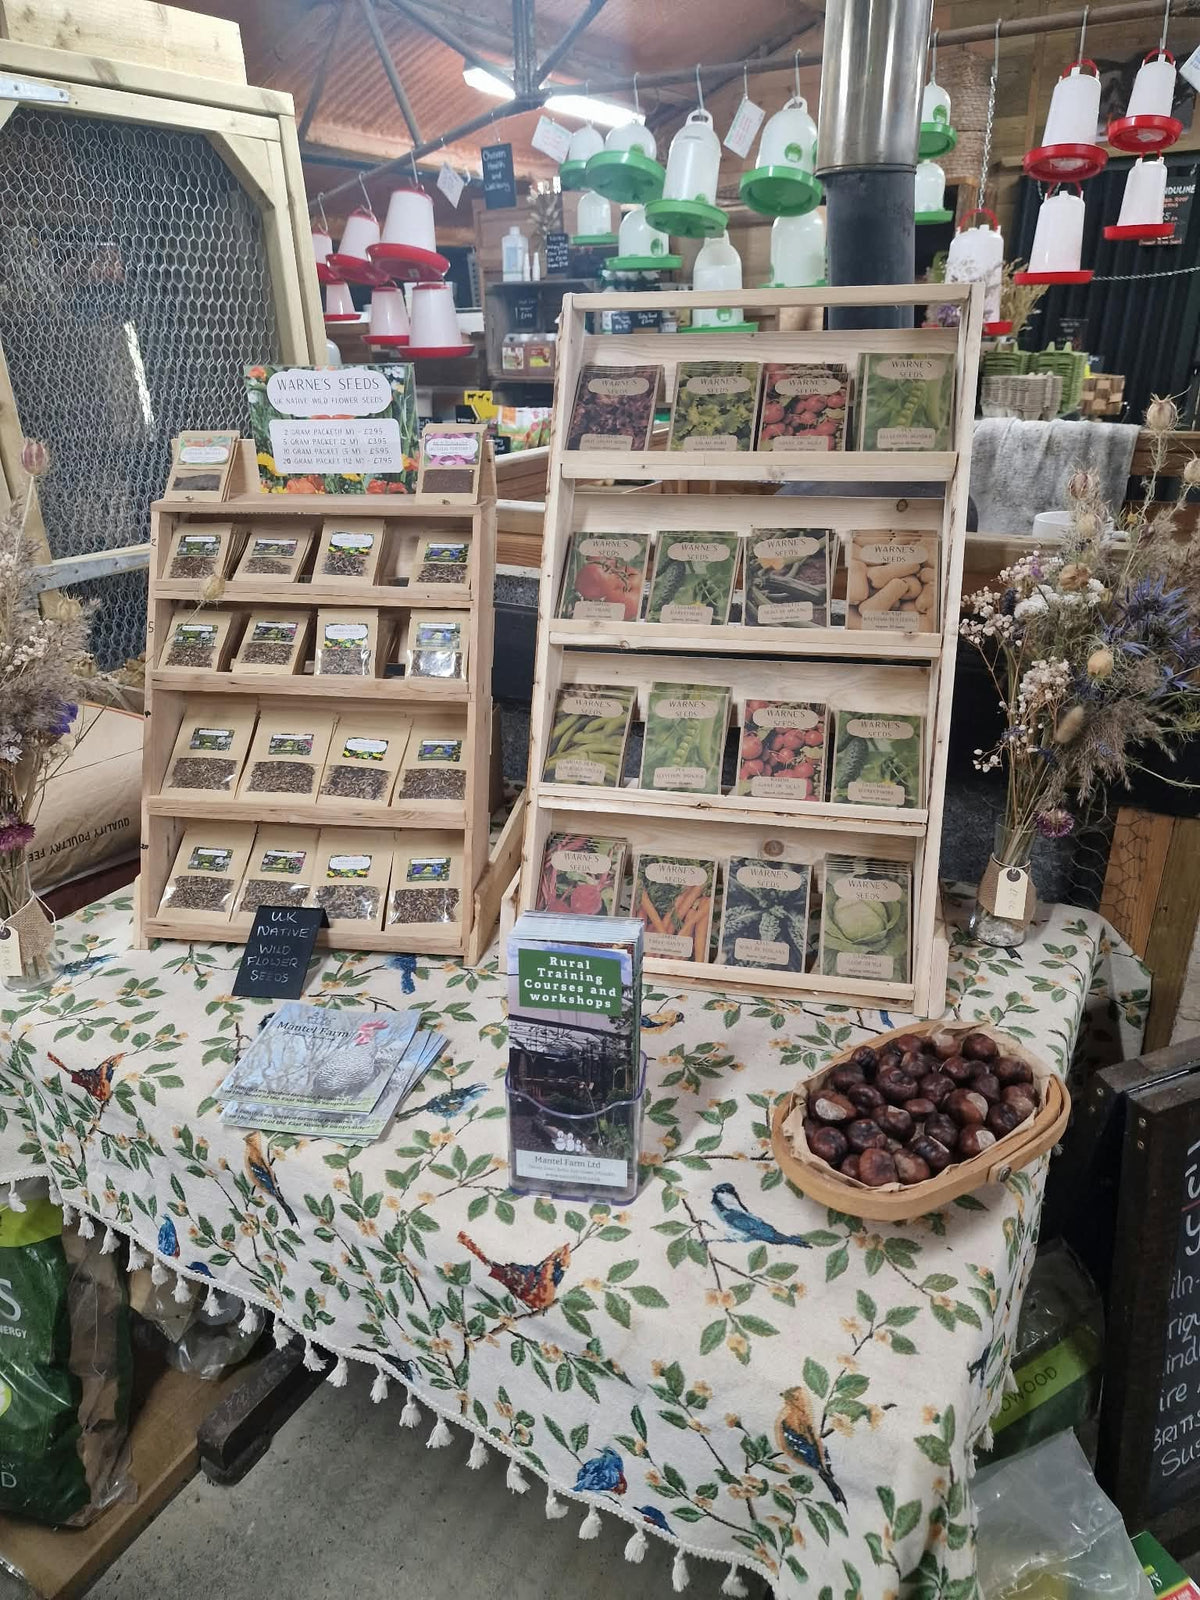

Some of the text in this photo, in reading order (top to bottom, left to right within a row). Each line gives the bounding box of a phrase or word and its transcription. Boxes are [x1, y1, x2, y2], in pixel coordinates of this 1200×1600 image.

[1164, 184, 1196, 194] NDULINE
[891, 360, 933, 369] WARNE'S
[276, 377, 380, 391] WARNE'S SEEDS
[601, 379, 638, 387] WARNE'S
[700, 377, 739, 386] WARNE'S
[286, 397, 308, 405] NATIVE
[283, 438, 288, 446] 5
[290, 438, 311, 446] GRAM
[592, 540, 629, 549] WARNE'S
[767, 539, 806, 549] WARNE'S
[874, 545, 915, 554] WARNE'S
[881, 555, 906, 563] SEEDS
[148, 620, 154, 633] 5
[575, 700, 612, 708] WARNE'S
[668, 700, 706, 708] WARNE'S
[766, 709, 806, 718] WARNE'S
[860, 721, 901, 730] WARNE'S
[868, 730, 892, 738] SEEDS
[93, 817, 130, 839] QUALITY
[49, 831, 91, 855] POULTRY
[563, 853, 600, 863] WARNE'S
[569, 864, 591, 872] SEEDS
[658, 864, 696, 875] WARNE'S
[749, 867, 789, 879] WARNE'S
[664, 876, 687, 884] SEEDS
[756, 880, 780, 889] SEEDS
[848, 879, 889, 890] WARNE'S
[855, 892, 881, 901] SEEDS
[271, 911, 298, 924] UK
[256, 925, 310, 939] NATIVE
[259, 943, 292, 956] WILD
[247, 955, 298, 969] FLOWER
[549, 956, 590, 970] Rural
[250, 969, 289, 984] SEEDS
[537, 967, 603, 986] Training
[524, 979, 617, 998] Courses and
[529, 993, 612, 1009] workshops
[277, 1021, 318, 1034] Mantel
[319, 1027, 349, 1038] Farm
[535, 1155, 602, 1169] Mantel Farm Ltd
